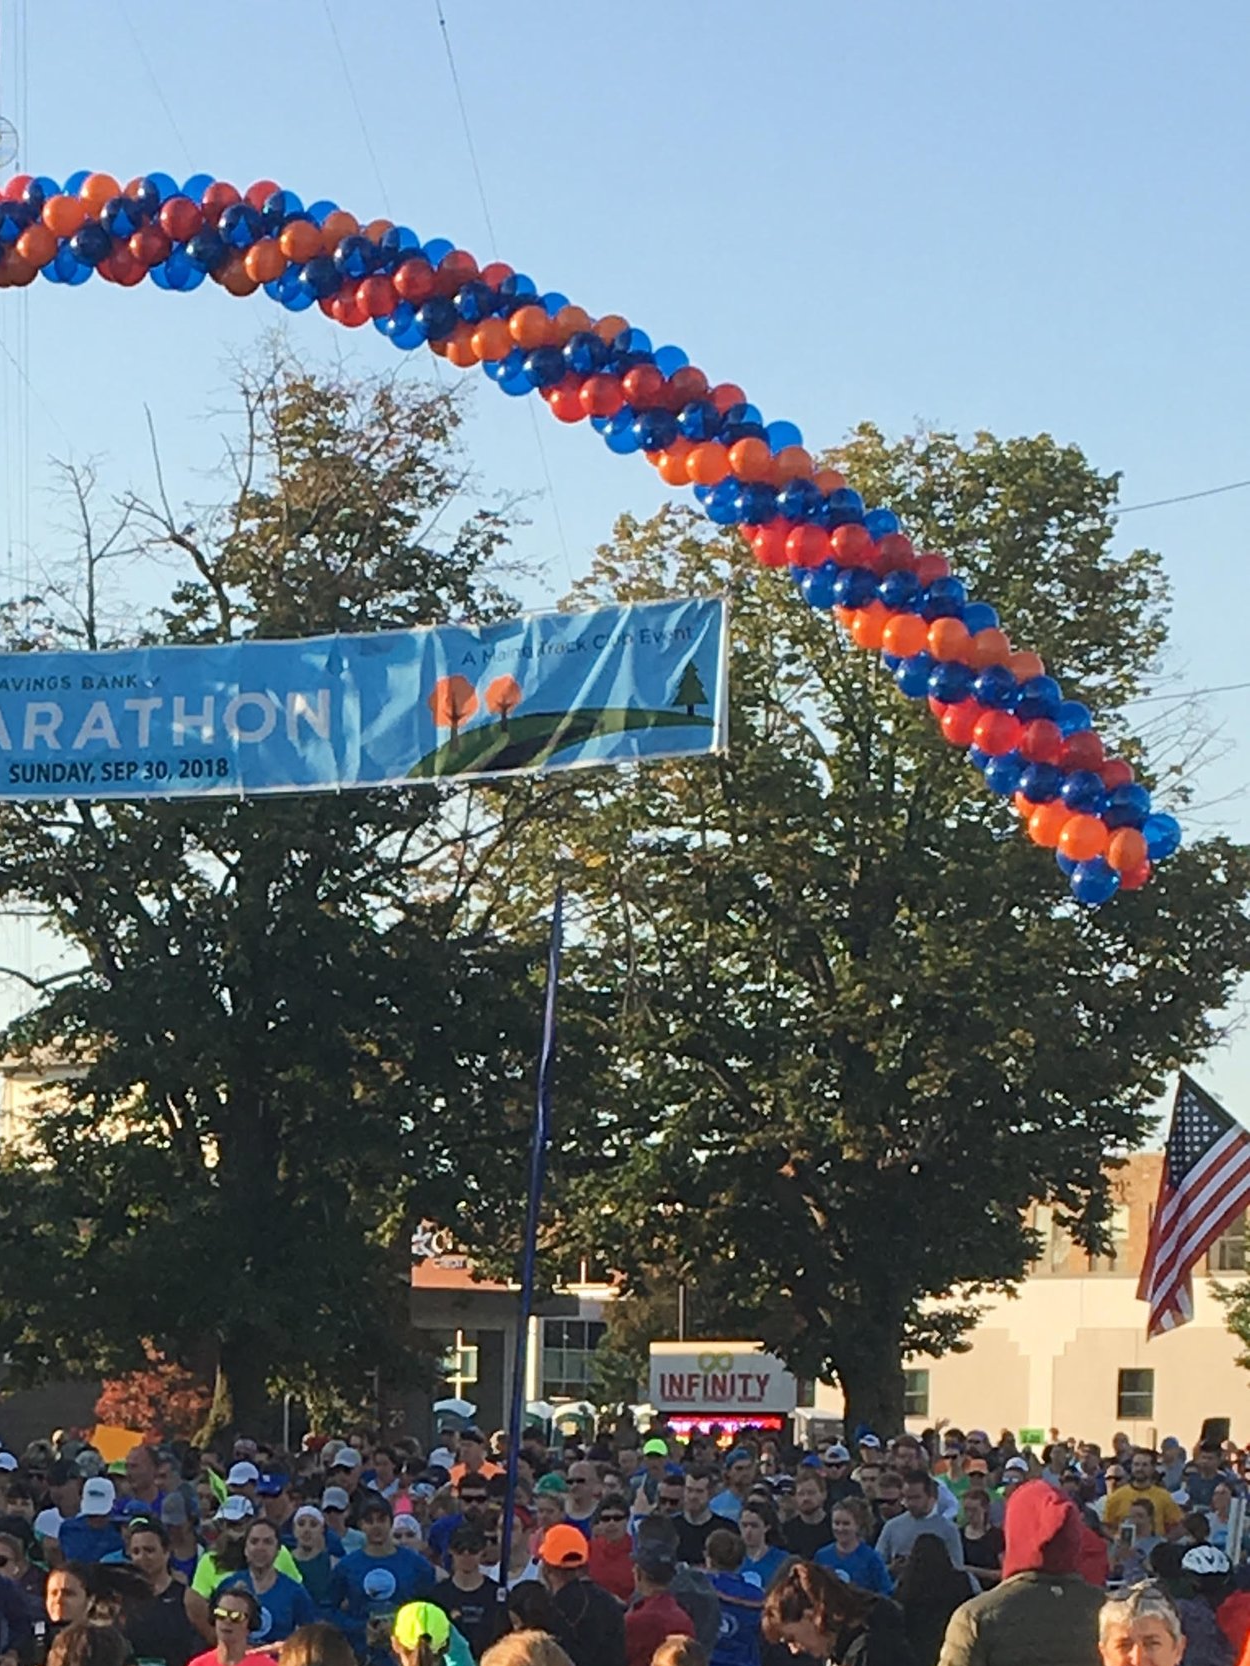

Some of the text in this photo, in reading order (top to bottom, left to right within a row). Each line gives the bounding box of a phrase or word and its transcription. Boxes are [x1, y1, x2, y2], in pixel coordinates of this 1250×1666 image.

[461, 652, 477, 667] A
[81, 674, 138, 690] BANK
[8, 762, 96, 784] SUNDAY,
[101, 760, 138, 782] SEP
[144, 761, 173, 782] 30,
[178, 757, 229, 779] 2018
[659, 1373, 770, 1397] INFINITY
